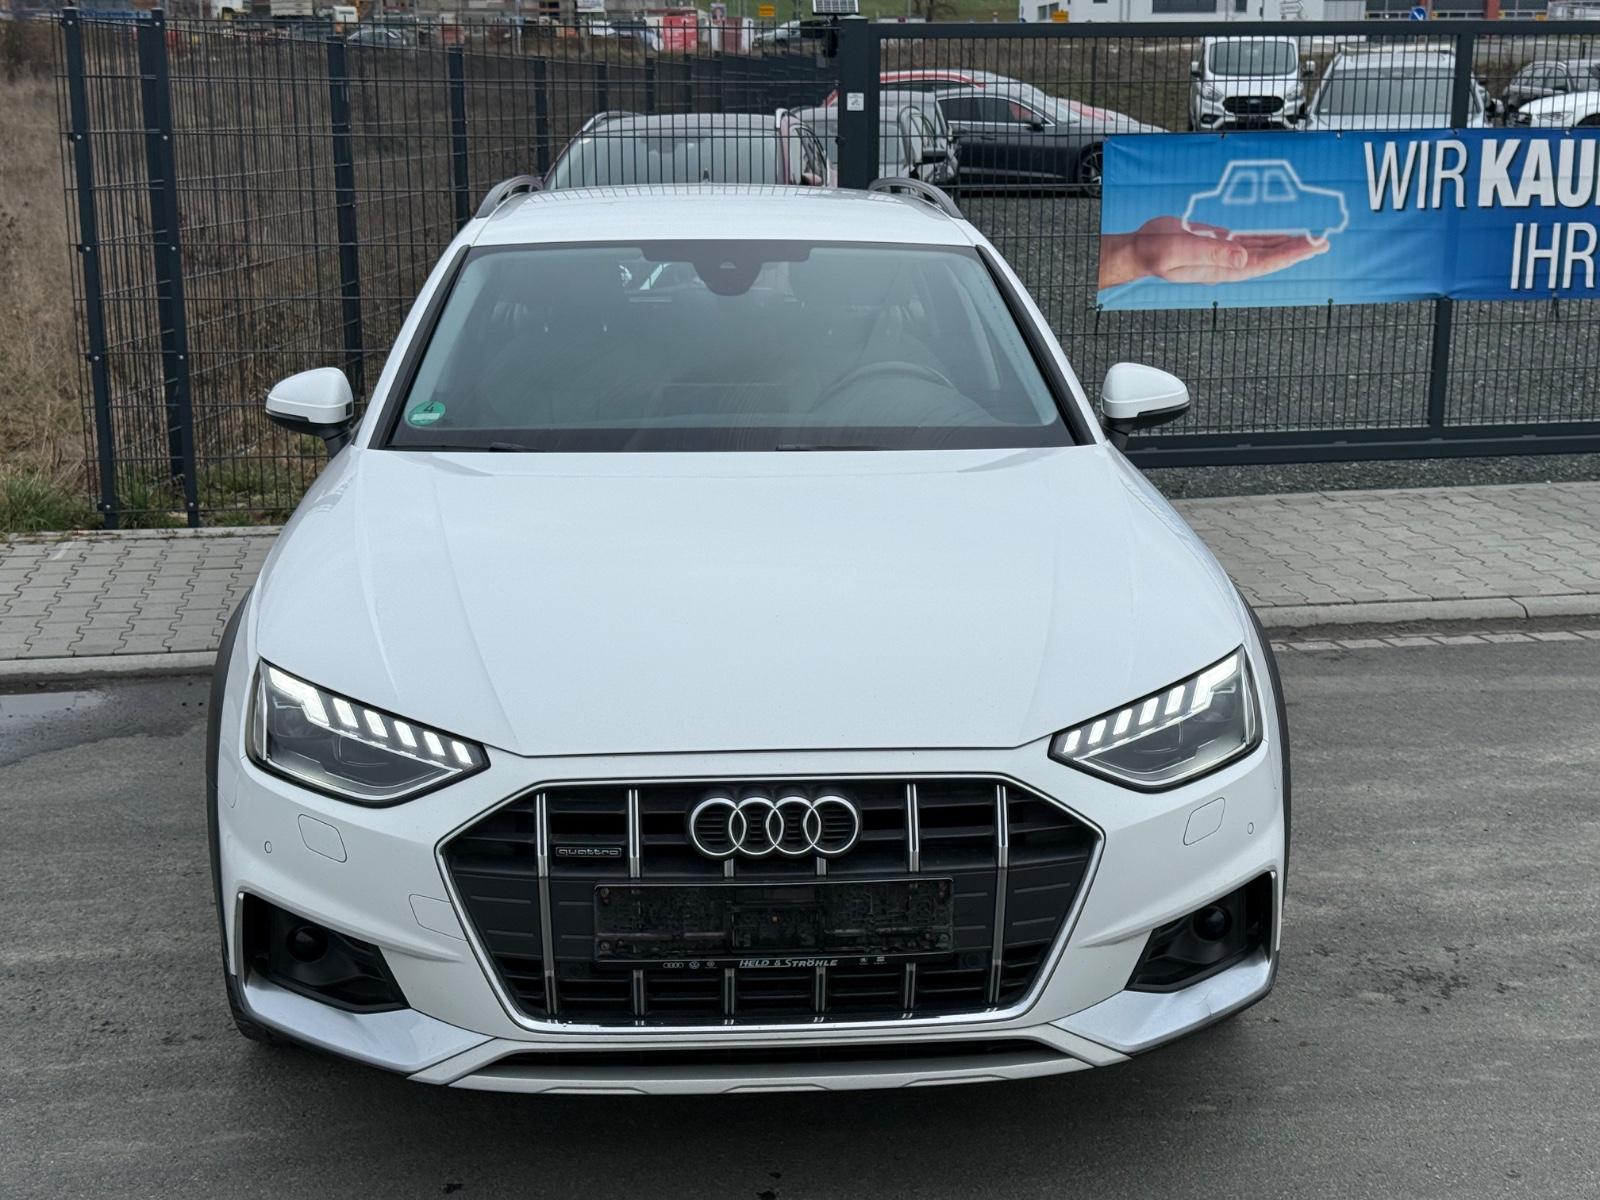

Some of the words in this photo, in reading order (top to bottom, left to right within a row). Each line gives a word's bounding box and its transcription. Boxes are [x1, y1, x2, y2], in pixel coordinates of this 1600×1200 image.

[1364, 139, 1467, 210] WIR
[1478, 138, 1600, 208] KAU
[1510, 222, 1598, 289] IHR
[423, 401, 435, 414] 4
[558, 848, 619, 856] quattro
[739, 960, 770, 968] HELD
[785, 959, 838, 968] STRÖHLE
